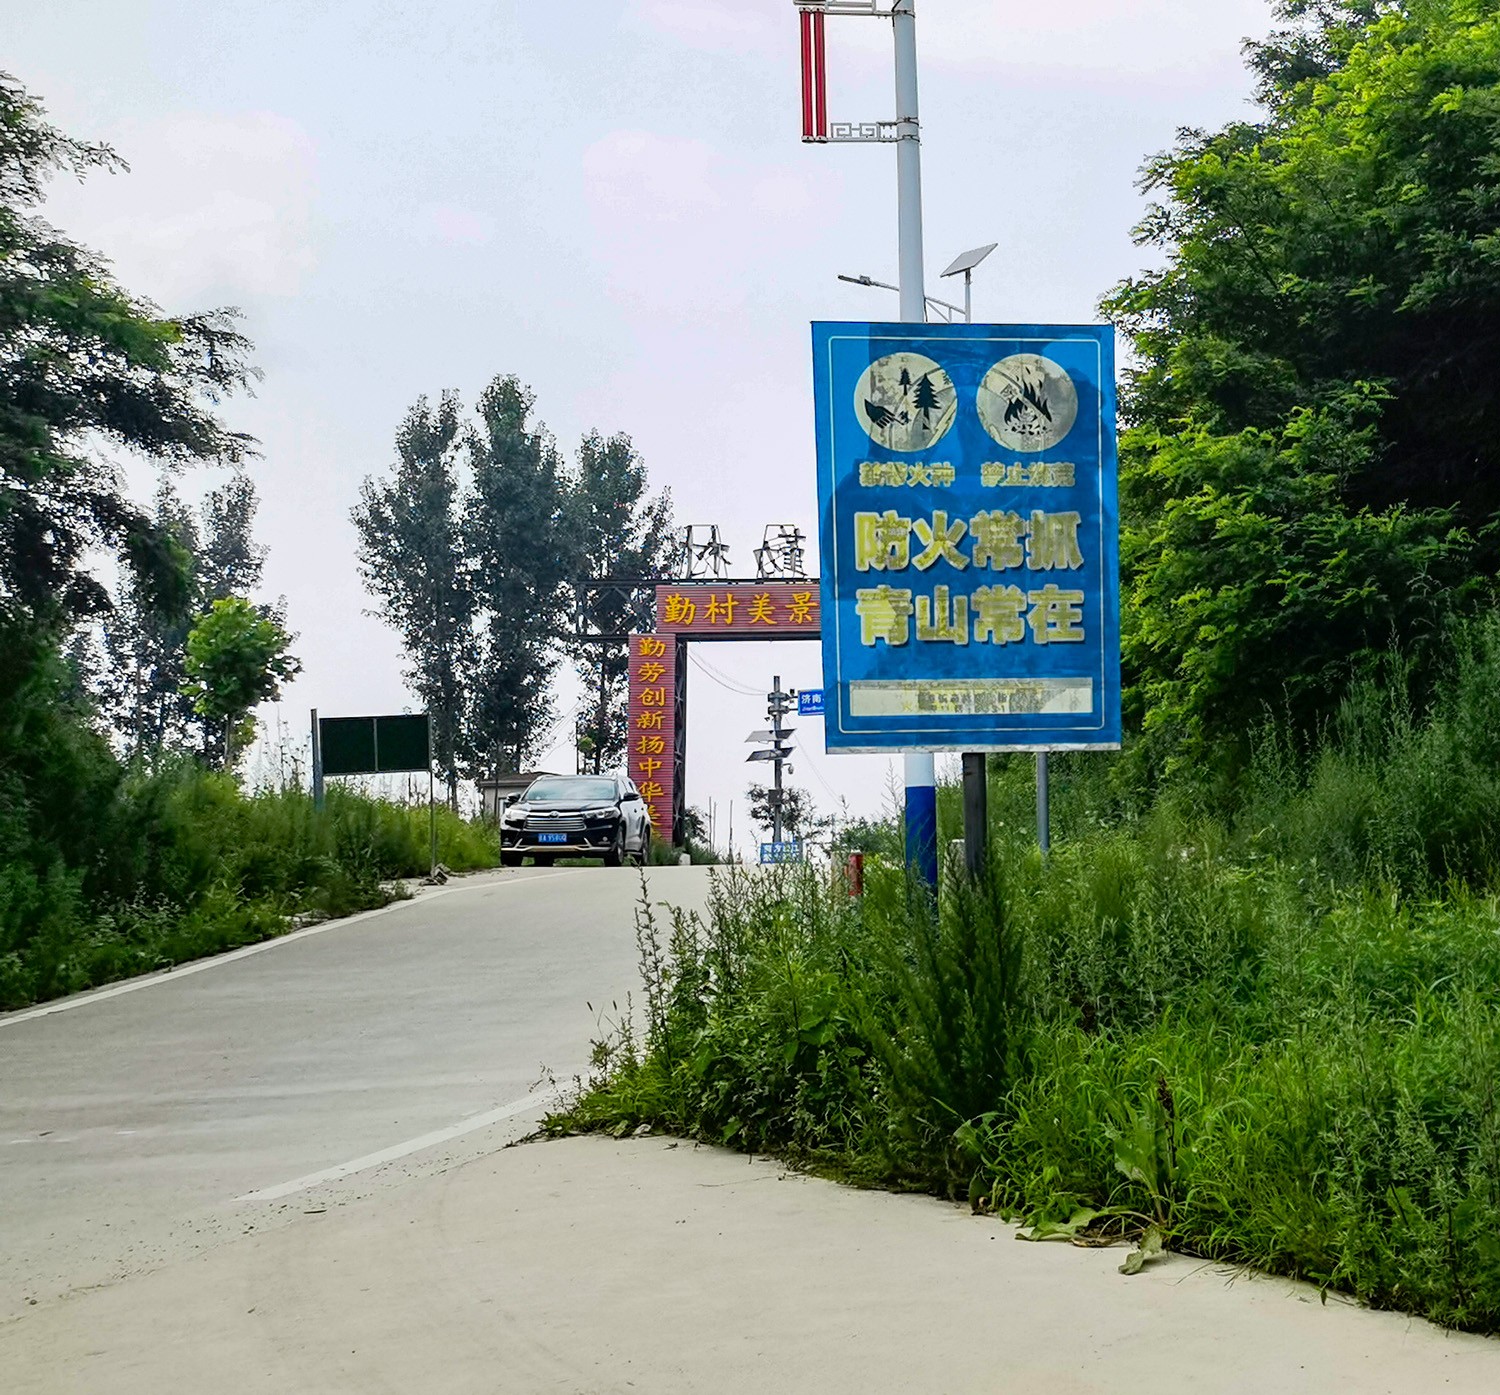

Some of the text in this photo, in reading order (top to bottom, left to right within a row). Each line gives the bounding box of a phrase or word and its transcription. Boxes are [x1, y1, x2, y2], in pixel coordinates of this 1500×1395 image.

[854, 510, 1085, 572] 防火常抓
[662, 591, 818, 625] 勤村美景
[855, 583, 1086, 646] 青山常在
